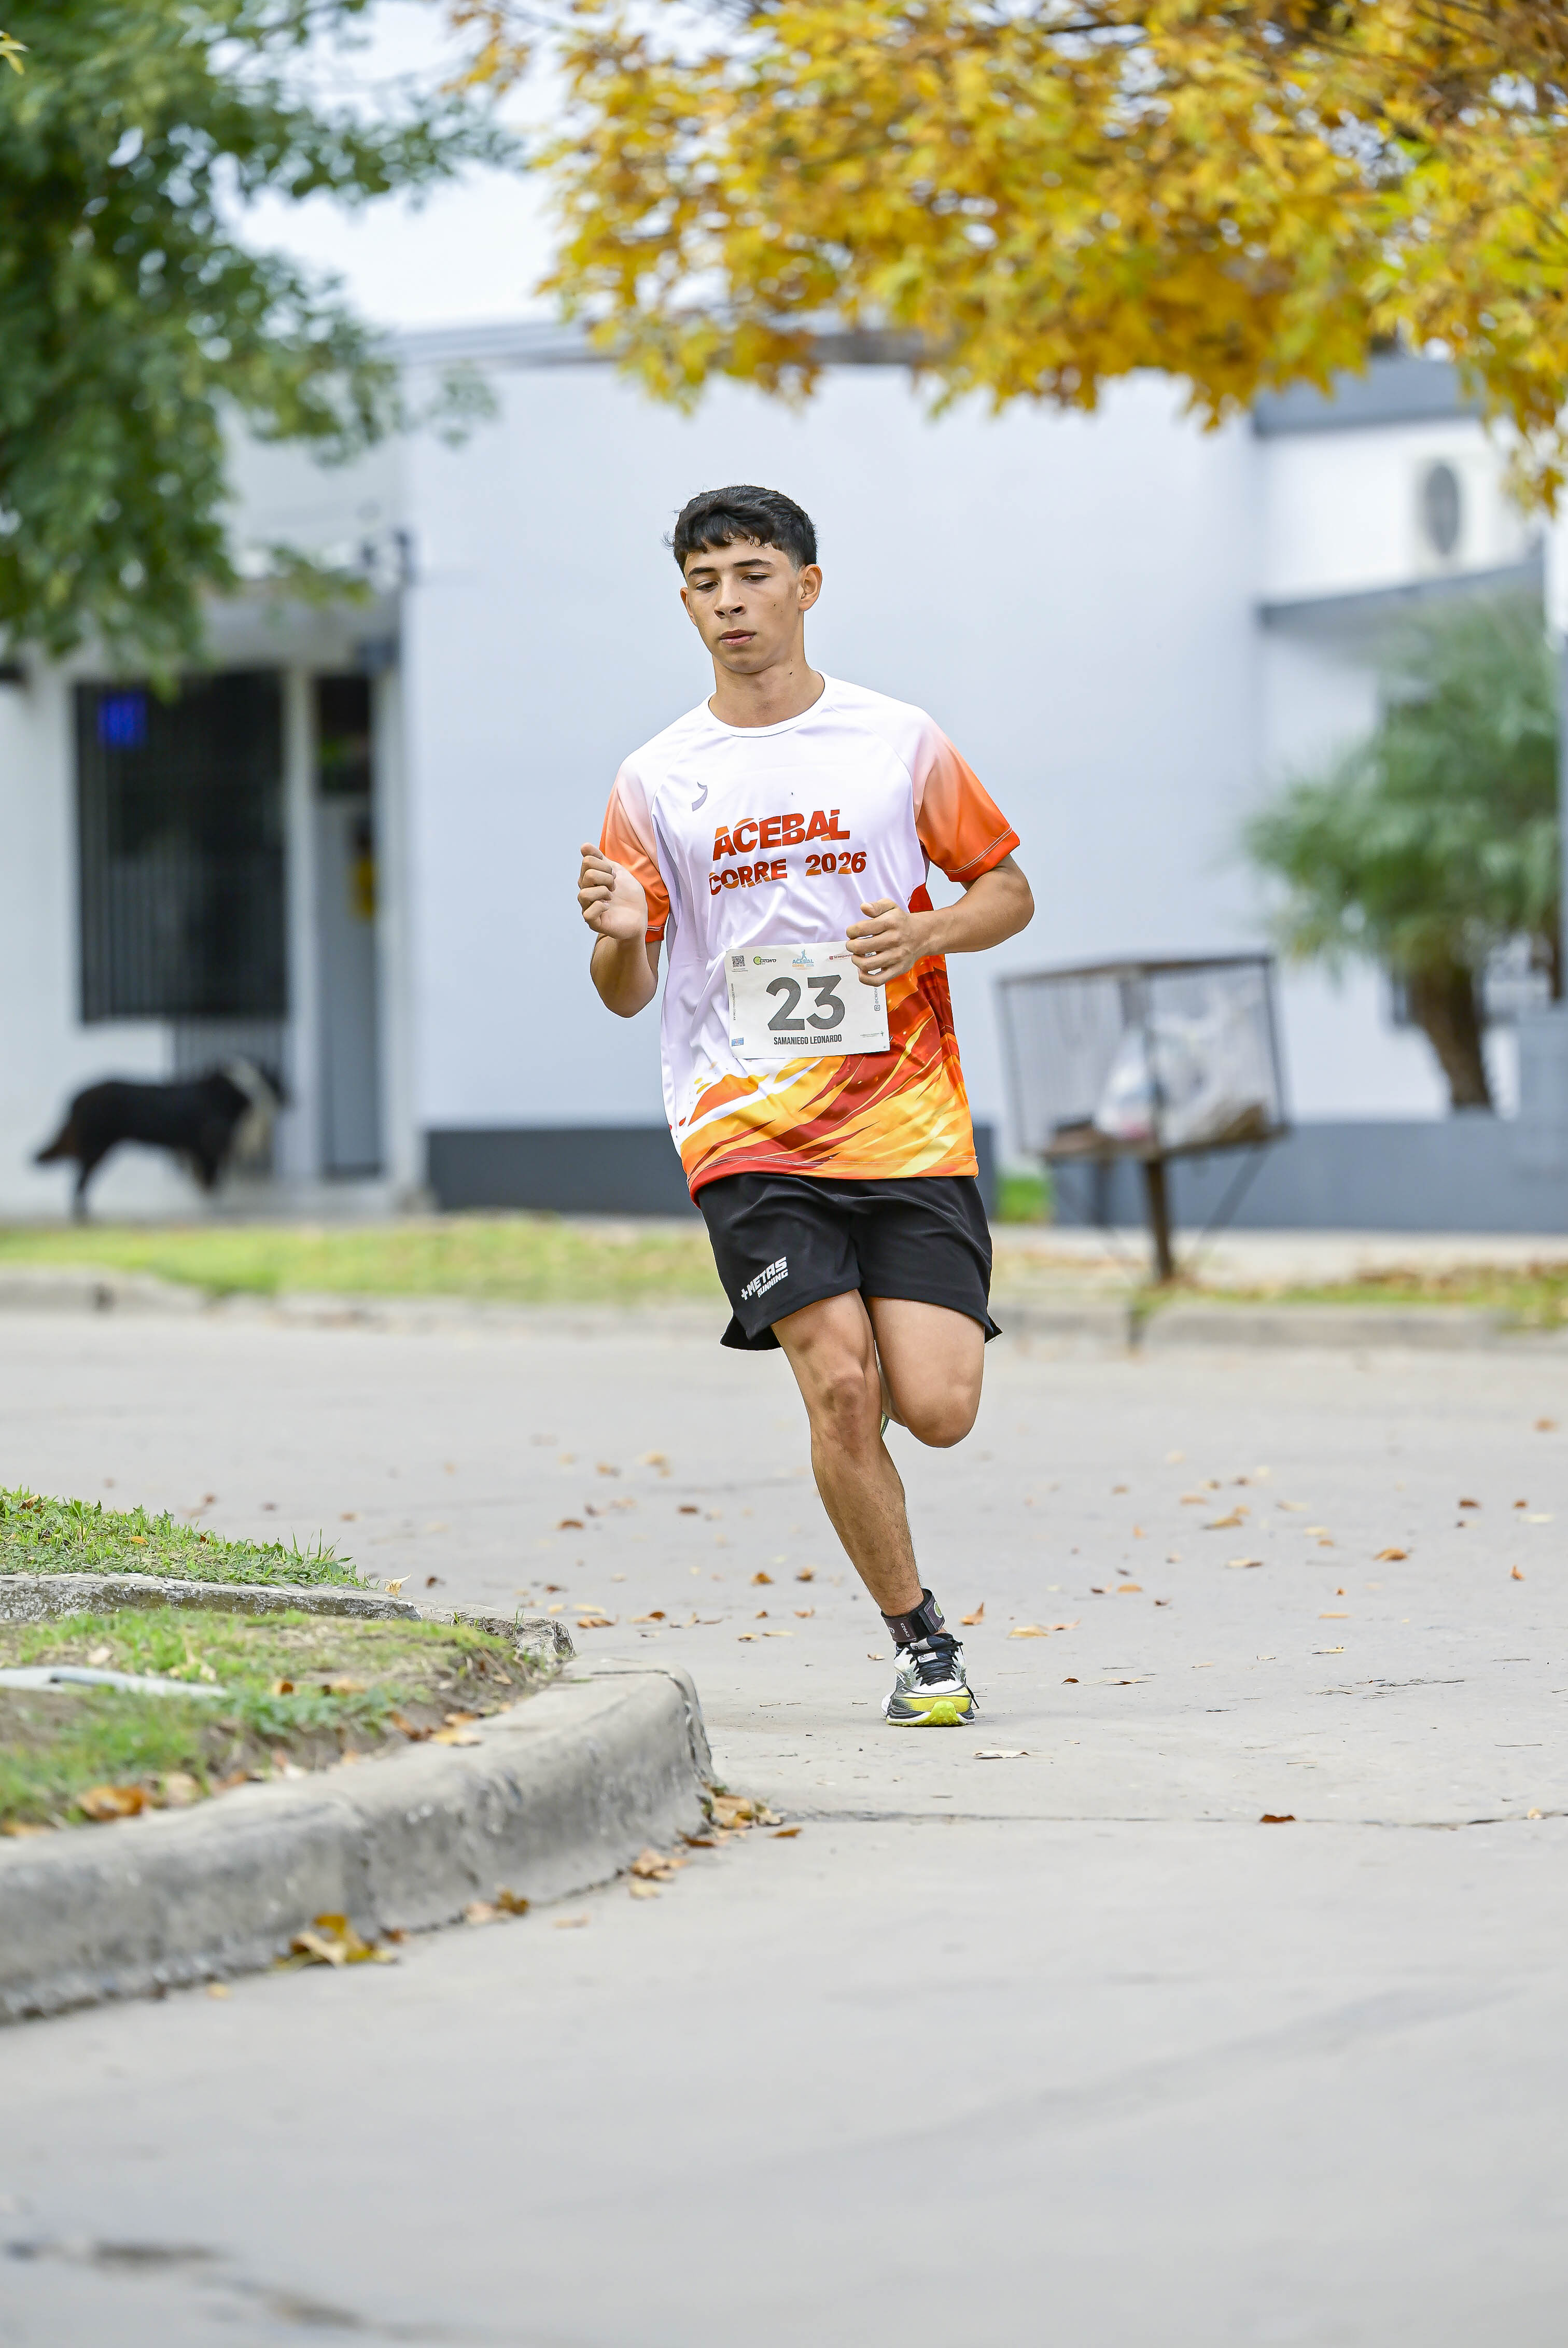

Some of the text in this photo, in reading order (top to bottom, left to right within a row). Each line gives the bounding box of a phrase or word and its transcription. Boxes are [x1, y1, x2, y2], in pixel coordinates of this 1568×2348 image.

[712, 809, 850, 861] ACEBAL
[708, 851, 867, 896] CORRE 2026
[766, 974, 846, 1031] 23
[774, 1034, 842, 1045] SAMANIEGO LEONARDO
[757, 1268, 789, 1298] RUNNING
